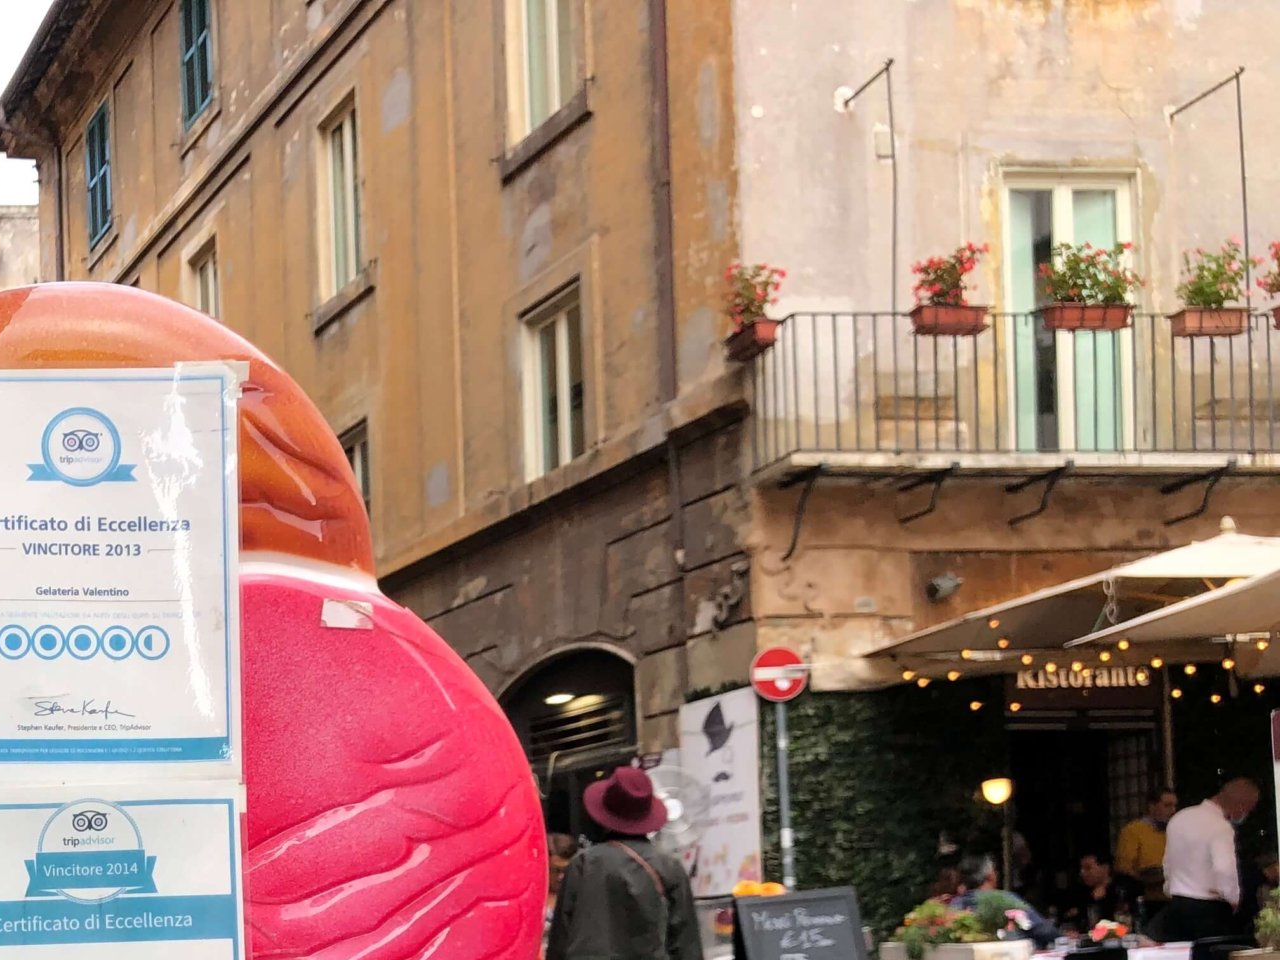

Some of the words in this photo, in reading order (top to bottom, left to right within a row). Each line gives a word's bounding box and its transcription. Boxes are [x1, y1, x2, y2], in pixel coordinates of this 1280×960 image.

[74, 514, 91, 532] di
[97, 515, 191, 533] Eccellenza
[22, 542, 100, 557] VINCITORE
[105, 543, 142, 557] 2013
[35, 585, 80, 597] Gelateria
[82, 586, 130, 598] Valentino
[1016, 665, 1151, 689] Ristorante
[17, 724, 42, 732] Stephen
[62, 834, 116, 848] tripadvisor
[43, 863, 104, 878] Vincitore
[106, 862, 139, 876] 2014
[84, 913, 101, 931] di
[105, 911, 193, 930] Eccellenza
